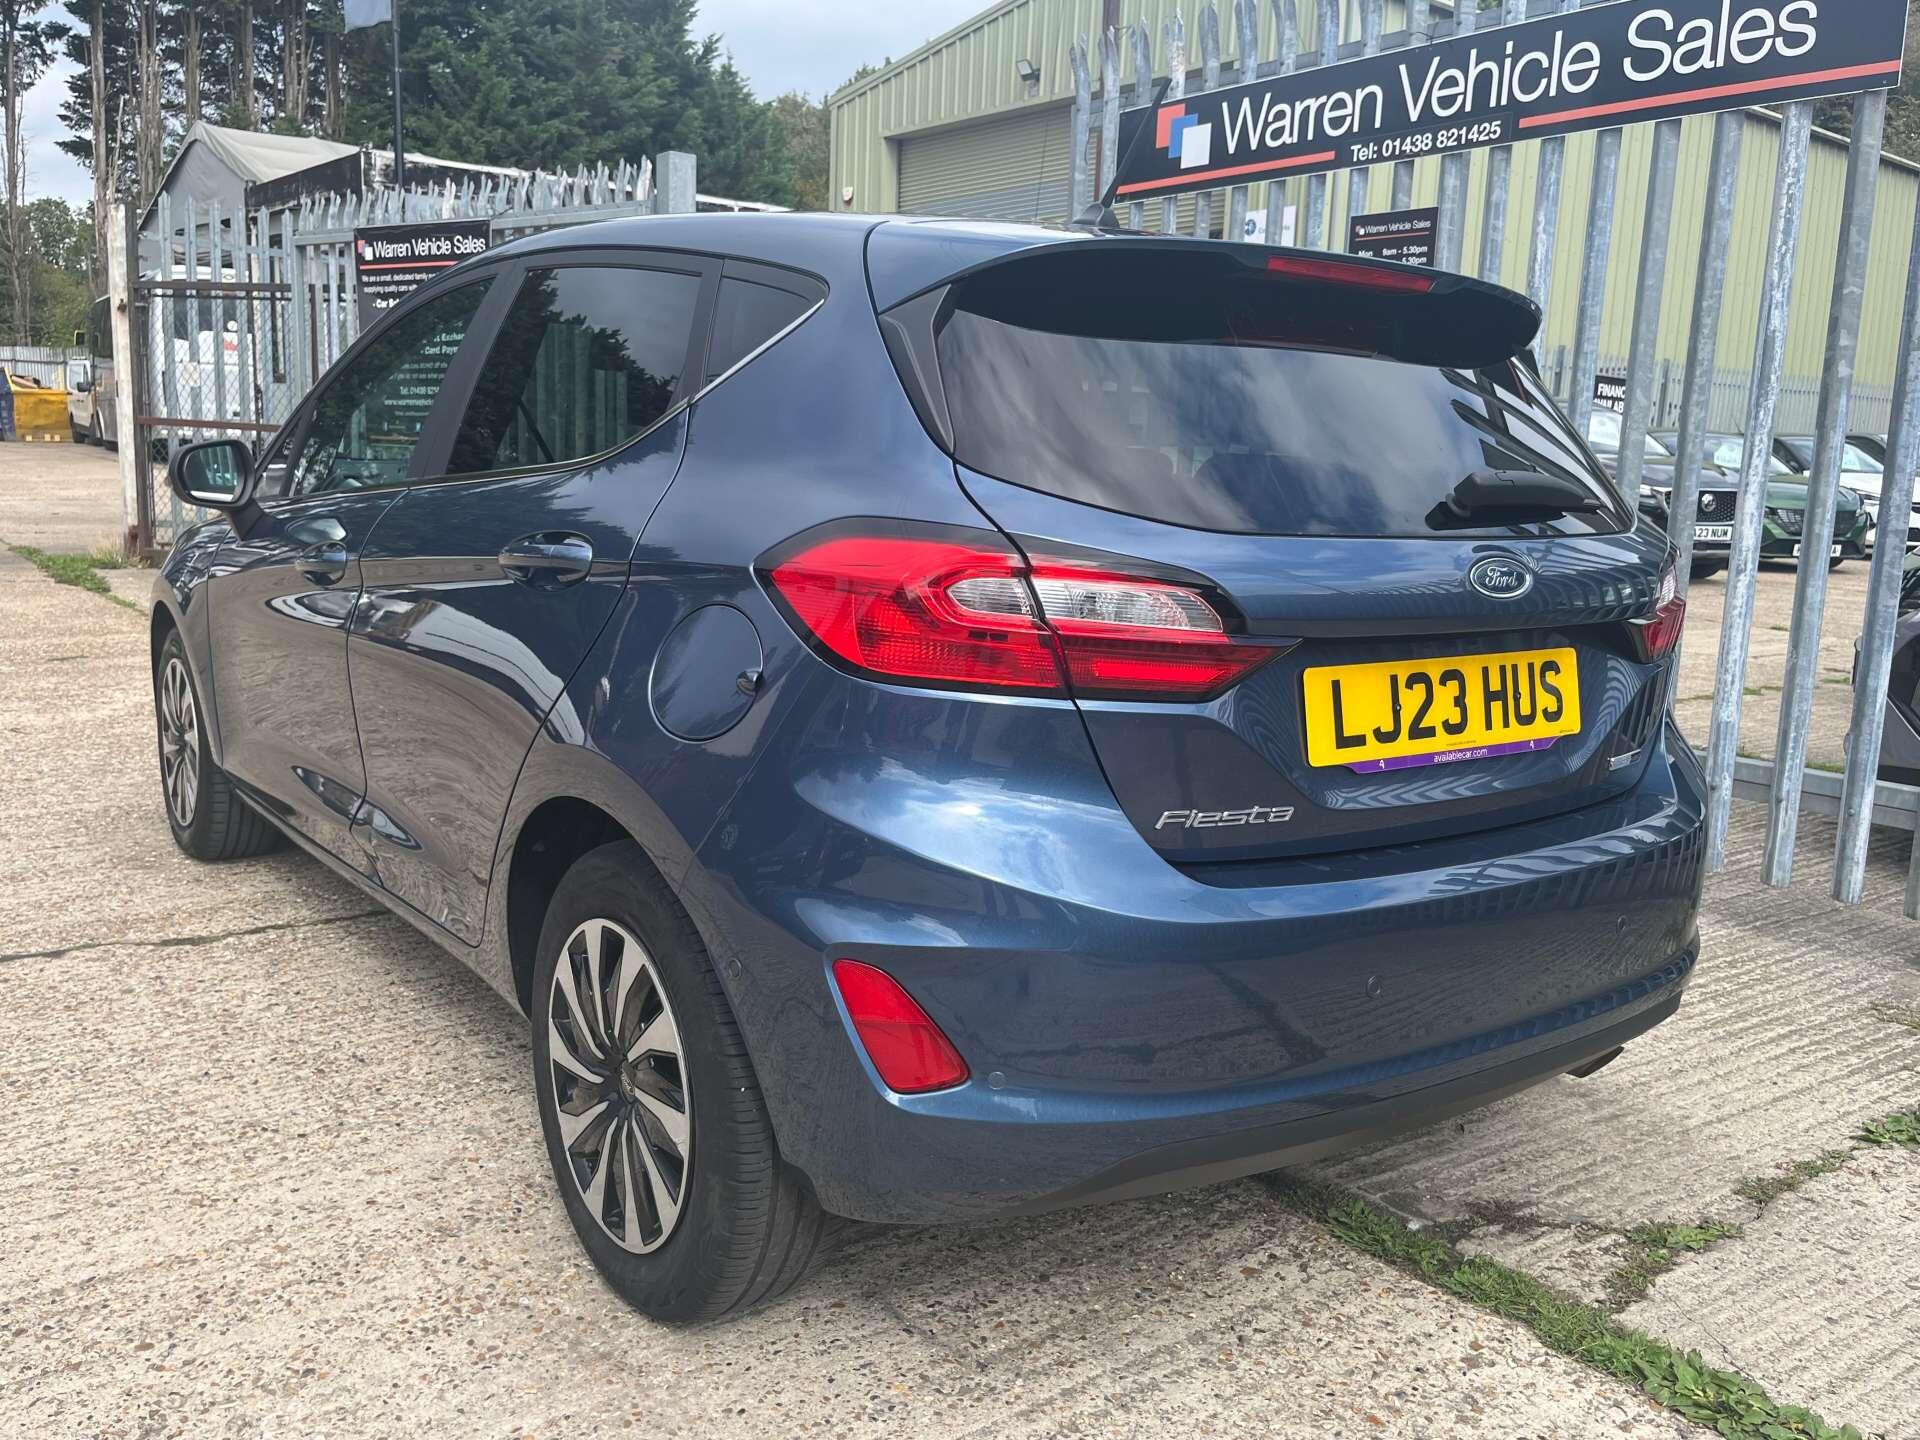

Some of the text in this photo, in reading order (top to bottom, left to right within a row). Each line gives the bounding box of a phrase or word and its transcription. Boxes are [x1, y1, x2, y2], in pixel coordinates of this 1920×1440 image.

[1222, 0, 1817, 156] Warren Vehicle Sales
[1350, 120, 1501, 163] Tel: 01438 821425
[1365, 220, 1431, 234] Warren Vehicle Sales
[373, 235, 486, 258] Warren Vehicle Sales
[1382, 248, 1397, 256] 9am
[1402, 246, 1428, 254] 5.30pm
[376, 298, 388, 308] Car
[1597, 383, 1626, 399] FINANC
[1711, 528, 1729, 538] NUM
[1485, 566, 1518, 588] Ford
[1331, 660, 1564, 750] LJ23 HUS
[1433, 748, 1489, 763] availablecar.com
[1155, 805, 1295, 830] Fiesta
